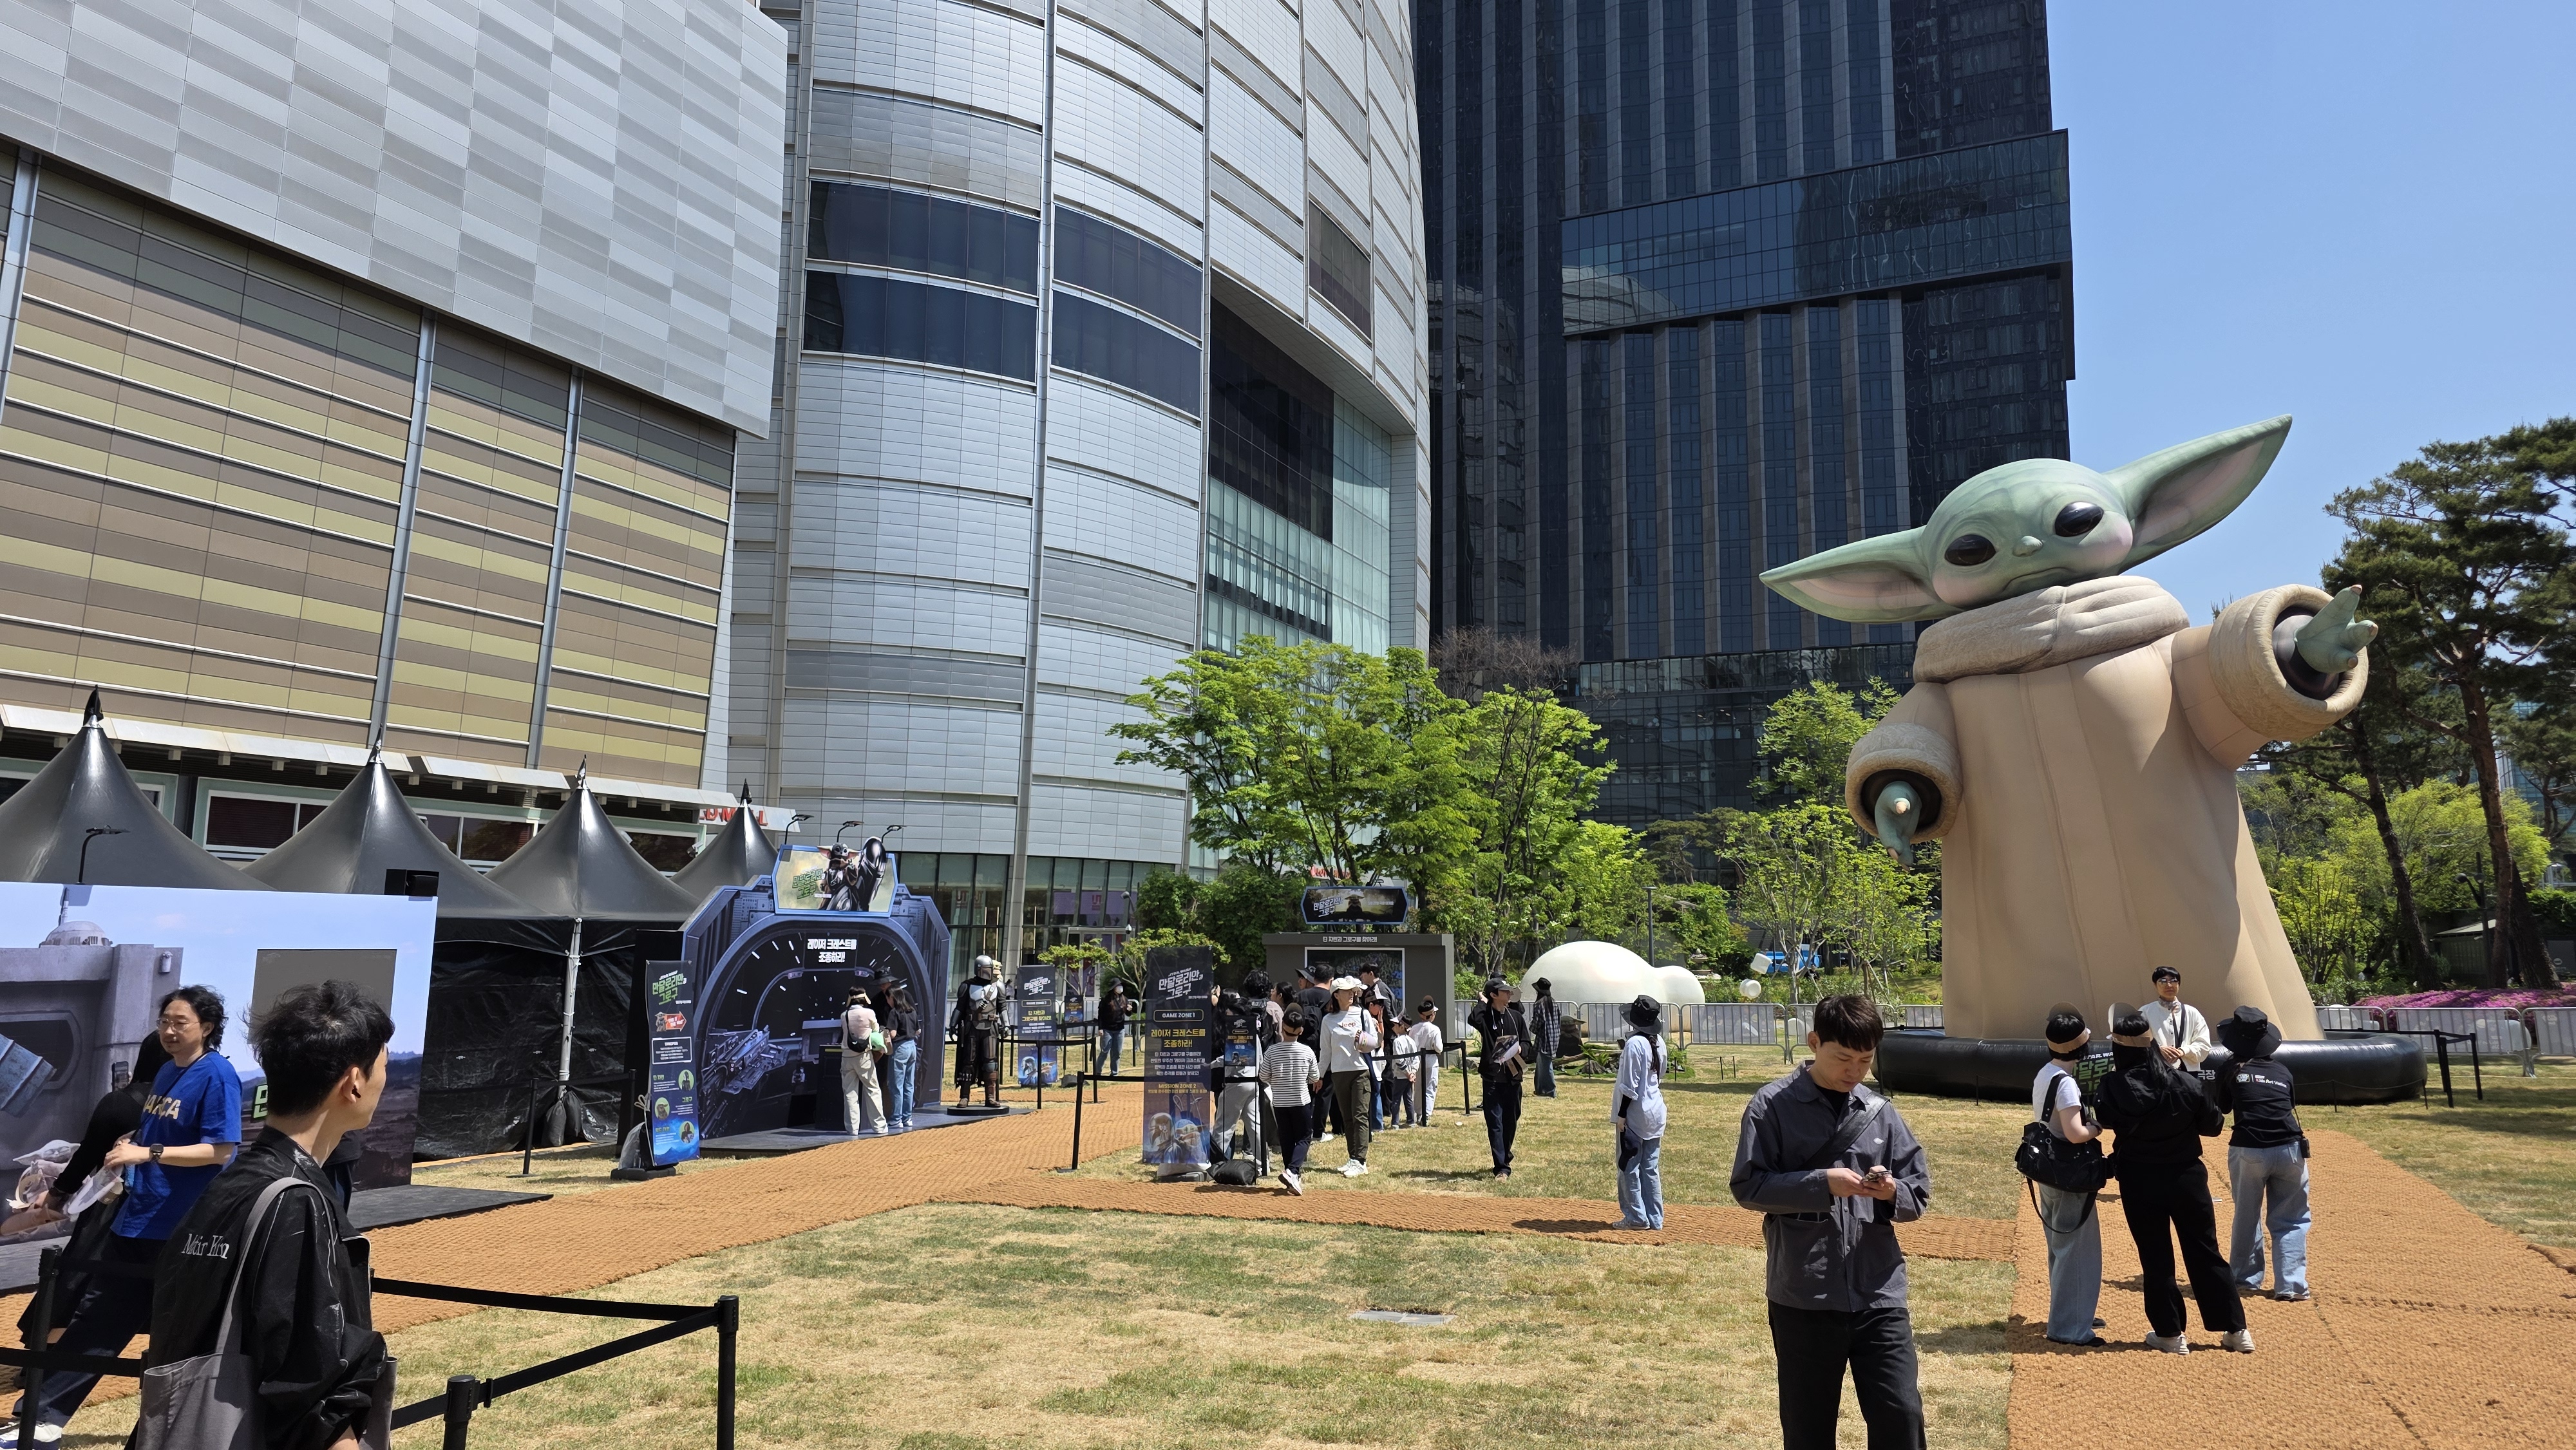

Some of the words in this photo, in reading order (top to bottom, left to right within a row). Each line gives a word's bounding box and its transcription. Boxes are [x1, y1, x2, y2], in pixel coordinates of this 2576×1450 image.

[721, 807, 768, 826] ML
[797, 881, 817, 899] 그로구
[1318, 906, 1336, 918] 그로구
[808, 939, 826, 950] 레이저
[819, 952, 846, 963] 조종하라!
[658, 987, 678, 1005] 그로구
[1166, 983, 1191, 1000] 그로구
[1151, 1029, 1171, 1037] 레이저
[1164, 1039, 1193, 1048] 조종하라!
